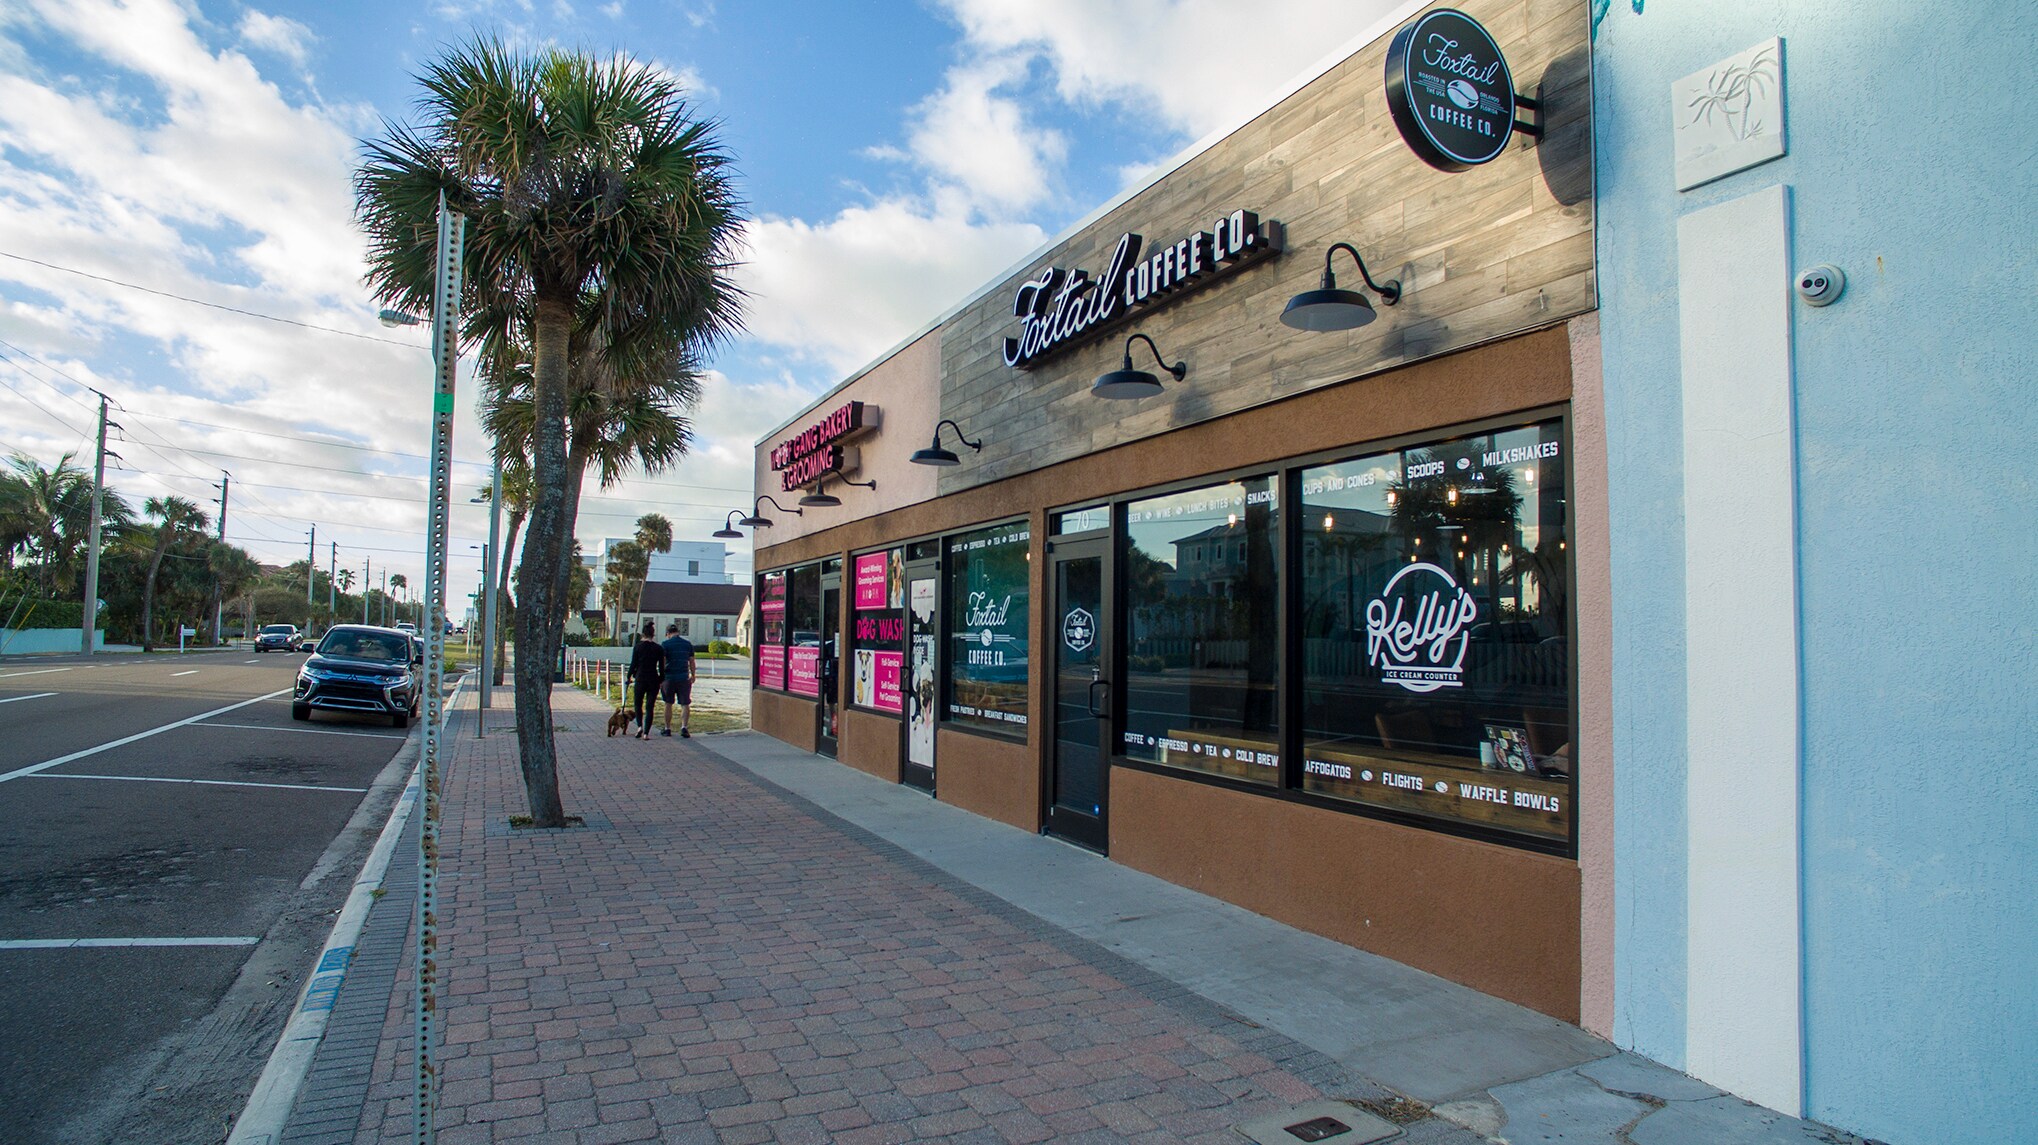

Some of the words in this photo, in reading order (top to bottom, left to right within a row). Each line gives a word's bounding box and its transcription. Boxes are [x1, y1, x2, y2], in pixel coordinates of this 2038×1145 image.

[1422, 33, 1500, 85] Foxtail
[1430, 104, 1473, 130] COFFEE
[1478, 119, 1496, 138] CO.
[1003, 232, 1131, 367] Foxtail
[1125, 231, 1203, 307] COFFEE
[1213, 209, 1255, 262] CO.
[793, 424, 819, 459] GANG
[820, 402, 853, 445] BAKERY
[787, 445, 833, 489] GROOMING
[1303, 481, 1324, 496] CUPS
[1327, 476, 1344, 491] AND
[1347, 473, 1376, 489] CONES
[1407, 460, 1445, 479] SCOOPS
[1482, 441, 1559, 467] MILKSHAKES
[1076, 511, 1090, 531] 70
[1156, 507, 1173, 519] WINE
[1187, 501, 1208, 514] LUNCH
[1247, 489, 1276, 505] SNACKS
[966, 591, 1011, 627] Foxtail
[1366, 586, 1477, 667] Kelly's
[968, 650, 993, 665] COFFEE
[994, 650, 1007, 666] CO.
[1386, 670, 1398, 679] ICE
[1399, 671, 1422, 680] CREAM
[1424, 672, 1459, 681] COUNTER
[1124, 732, 1145, 745] COFFEE
[1158, 737, 1189, 752] ESPRESSO
[1205, 744, 1218, 757] TEA
[1235, 749, 1254, 763] COLD
[1257, 753, 1280, 767] BREW
[1304, 760, 1352, 780] AFFOGATOS
[1382, 772, 1424, 791] FLIGHTS
[1460, 783, 1508, 805] WAFFLE
[1513, 791, 1560, 813] BOWLS
